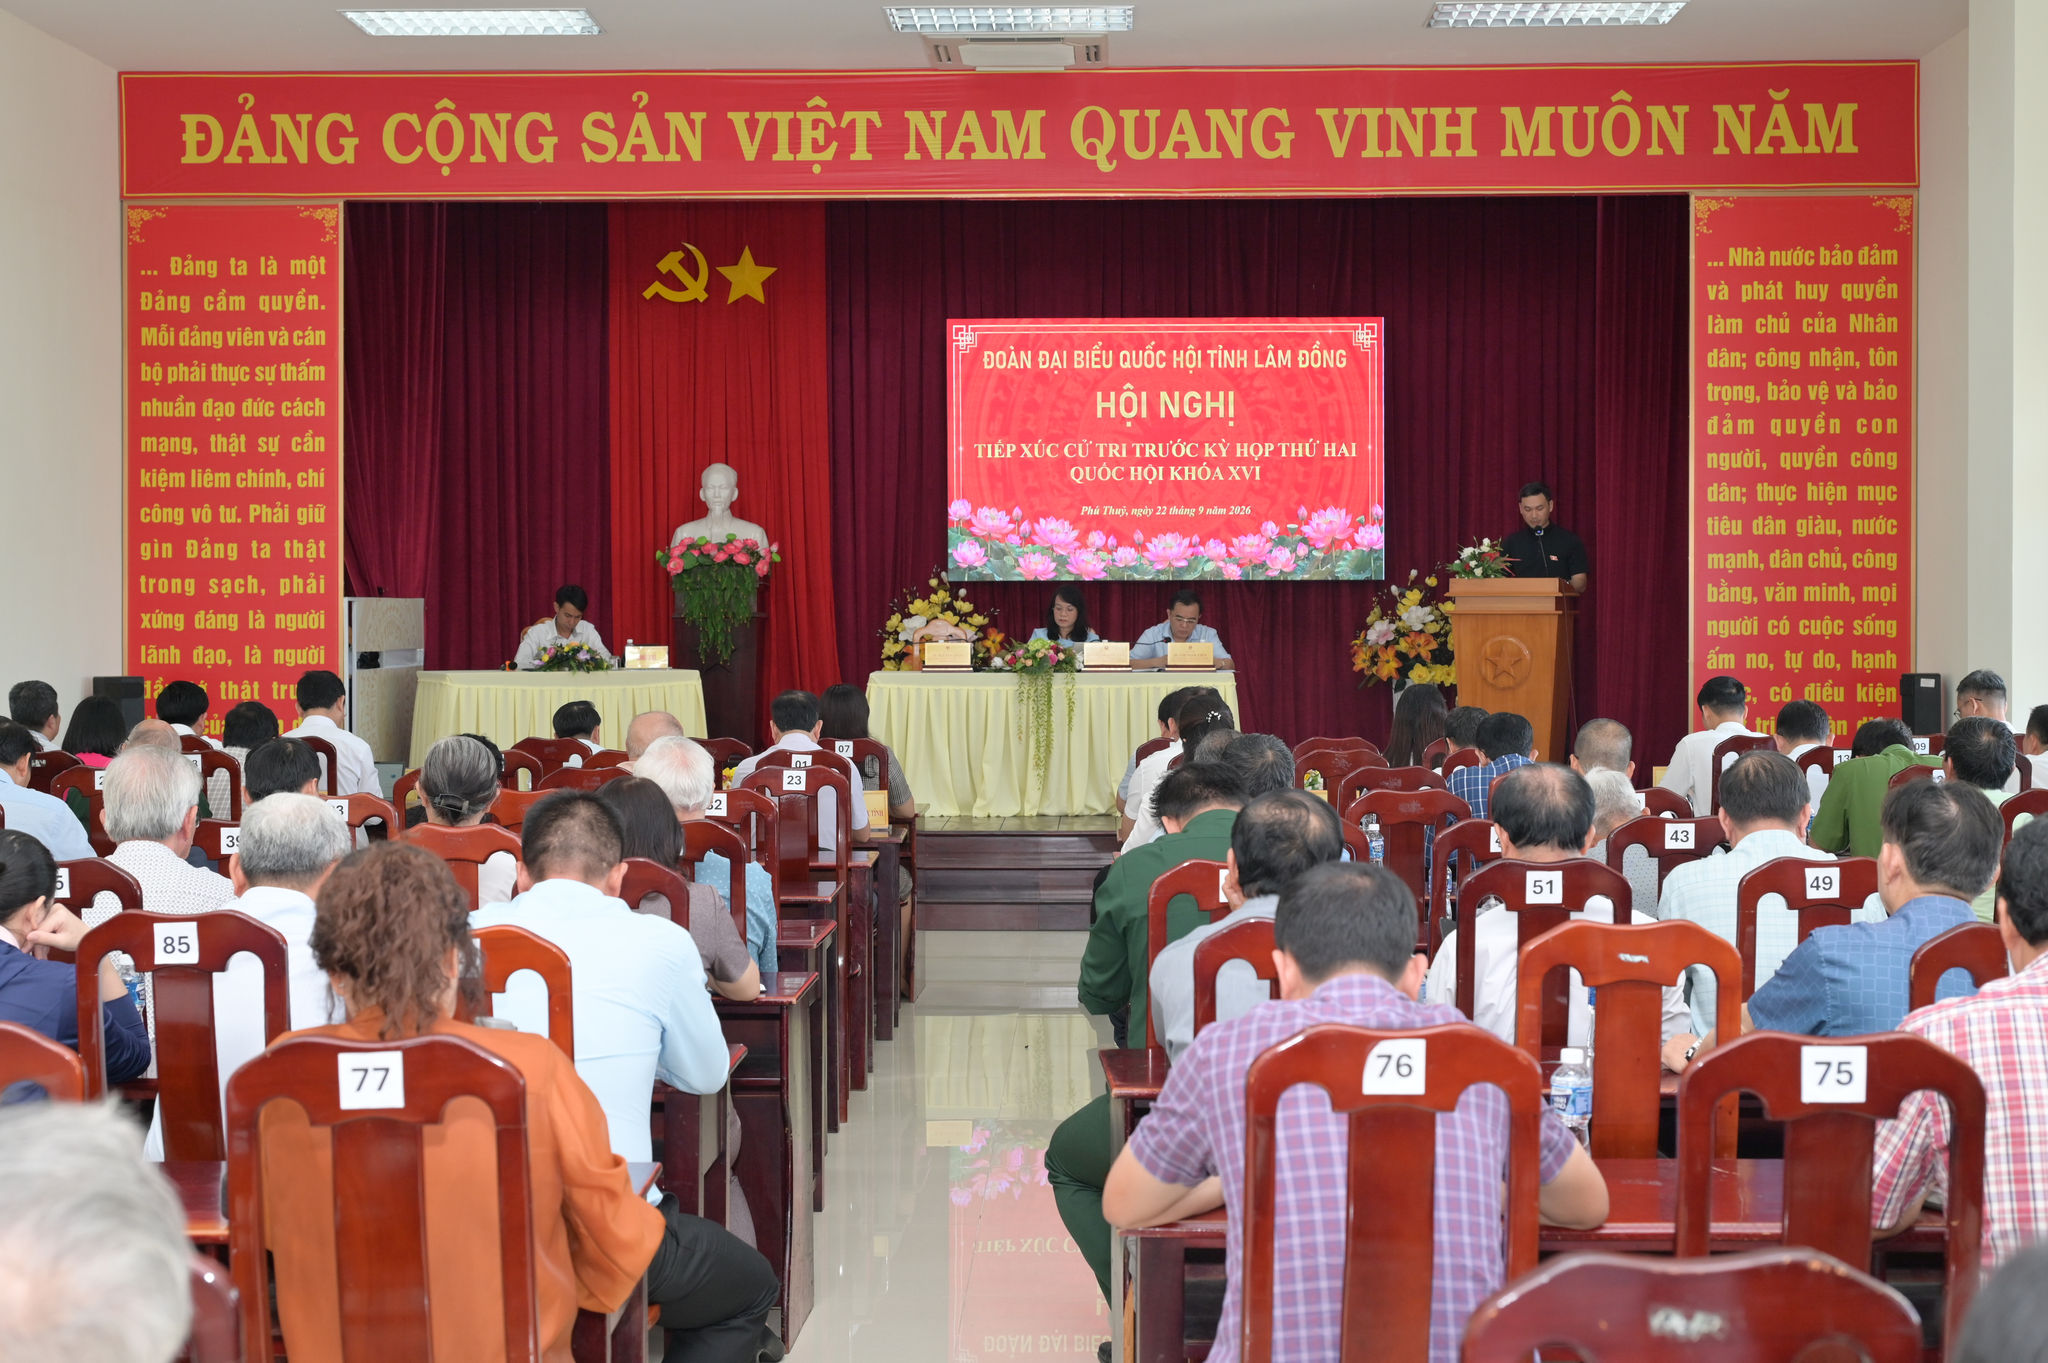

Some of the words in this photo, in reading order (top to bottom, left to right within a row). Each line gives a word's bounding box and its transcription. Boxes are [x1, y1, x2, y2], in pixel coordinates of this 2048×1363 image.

[181, 93, 359, 164] ĐẢNG
[383, 98, 558, 176] CỘNG
[582, 91, 706, 162] SẢN
[728, 96, 882, 174] VIỆT
[904, 110, 1046, 160] NAM
[1071, 106, 1295, 172] QUANG
[1316, 107, 1477, 158] VINH
[1501, 90, 1689, 157] MUÔN
[1713, 89, 1858, 154] NĂM
[170, 254, 218, 279] Đảng
[229, 257, 248, 276] ta
[260, 255, 278, 276] là
[290, 255, 327, 280] một
[1728, 246, 1765, 267] Nhà
[1769, 246, 1815, 267] nước
[1819, 243, 1854, 266] bảo
[1858, 243, 1898, 266] đảm
[140, 289, 191, 314] Đảng
[203, 288, 246, 312] cầm
[258, 287, 326, 313] quyền.
[1706, 280, 1729, 301] và
[1741, 280, 1784, 303] phát
[1795, 280, 1829, 302] huy
[1841, 276, 1898, 302] quyền
[1707, 314, 1743, 335] làm
[1755, 311, 1790, 334] chủ
[1802, 311, 1837, 334] của
[1849, 312, 1898, 333] Nhân
[141, 323, 175, 347] Mỗi
[178, 325, 223, 349] đảng
[226, 326, 265, 347] viên
[267, 326, 289, 347] và
[292, 325, 326, 347] cán
[983, 346, 1031, 369] ĐOÀN
[1038, 351, 1066, 374] ĐẠI
[1074, 342, 1112, 368] BIỂU
[1120, 341, 1166, 368] QUỐC
[1173, 345, 1201, 374] HỘI
[1207, 345, 1247, 368] TỈNH
[1255, 344, 1291, 368] LÂM
[1298, 341, 1346, 368] ĐỒNG
[1707, 347, 1747, 370] dân;
[1755, 347, 1801, 370] công
[1809, 346, 1861, 371] nhận,
[1868, 346, 1898, 367] tôn
[141, 362, 163, 386] bộ
[167, 360, 207, 385] phải
[210, 362, 251, 387] thực
[255, 364, 278, 386] sự
[280, 358, 326, 382] thấm
[1706, 382, 1761, 406] trọng,
[1767, 378, 1802, 401] bảo
[1807, 380, 1829, 405] vệ
[1835, 380, 1857, 401] và
[1863, 378, 1898, 401] bảo
[141, 394, 196, 417] nhuần
[202, 398, 236, 422] đạo
[241, 397, 275, 417] đức
[281, 396, 326, 417] cách
[1097, 383, 1147, 427] HỘI
[1160, 391, 1234, 426] NGHỊ
[1707, 412, 1755, 436] đảm
[1770, 411, 1841, 437] quyền
[1856, 417, 1898, 434] con
[140, 436, 198, 457] mạng,
[209, 432, 247, 457] thật
[257, 434, 281, 457] sự
[291, 429, 326, 453] cần
[974, 440, 1016, 458] TIẾP
[1020, 439, 1059, 458] XÚC
[1064, 439, 1092, 457] CỬ
[1096, 443, 1127, 457] TRI
[1132, 439, 1198, 457] TRƯỚC
[1205, 439, 1230, 457] KỲ
[1236, 443, 1274, 461] HỌP
[1278, 438, 1319, 457] THỨ
[1324, 443, 1356, 457] HAI
[1707, 448, 1767, 471] người,
[1780, 444, 1838, 471] quyền
[1850, 447, 1898, 471] công
[140, 467, 186, 492] kiệm
[191, 468, 231, 489] liêm
[236, 467, 292, 490] chính,
[296, 467, 326, 488] chí
[1070, 463, 1124, 484] QUỐC
[1130, 464, 1163, 484] HỘI
[1170, 463, 1224, 480] KHÓA
[1228, 466, 1260, 480] XVI
[1707, 482, 1747, 504] dân;
[1756, 482, 1797, 506] thực
[1807, 481, 1848, 506] hiện
[1857, 485, 1898, 506] mục
[140, 503, 185, 526] công
[191, 503, 213, 524] vô
[218, 504, 242, 524] tư.
[249, 501, 290, 524] Phải
[296, 503, 327, 526] giữ
[1707, 515, 1743, 537] tiêu
[1752, 515, 1787, 536] dân
[1796, 514, 1842, 538] giàu,
[1852, 515, 1898, 535] nước
[140, 538, 173, 561] gìn
[185, 537, 238, 561] Đảng
[251, 539, 271, 559] ta
[283, 538, 326, 563] thật
[1707, 578, 1759, 605] bằng,
[1764, 581, 1797, 602] văn
[1803, 582, 1856, 604] minh,
[1862, 583, 1897, 607] mọi
[140, 609, 185, 632] xứng
[194, 609, 239, 632] đáng
[248, 609, 266, 630] là
[274, 609, 326, 632] người
[140, 644, 181, 665] lãnh
[192, 645, 233, 669] đạo,
[244, 644, 262, 665] là
[273, 644, 326, 667] người
[1706, 646, 1736, 670] ấm
[1746, 652, 1775, 671] no,
[1784, 649, 1804, 673] tự
[1813, 649, 1841, 671] do,
[1851, 649, 1897, 673] hạnh
[838, 744, 851, 753] 07
[1837, 754, 1850, 763] 13
[794, 760, 807, 768] 01
[786, 775, 802, 786] 23
[1669, 829, 1690, 844] 43
[1532, 879, 1554, 895] 51
[1809, 875, 1834, 891] 49
[162, 935, 191, 954] 85
[1375, 1053, 1414, 1078] 76
[1813, 1060, 1854, 1086] 75
[351, 1067, 391, 1092] 77
